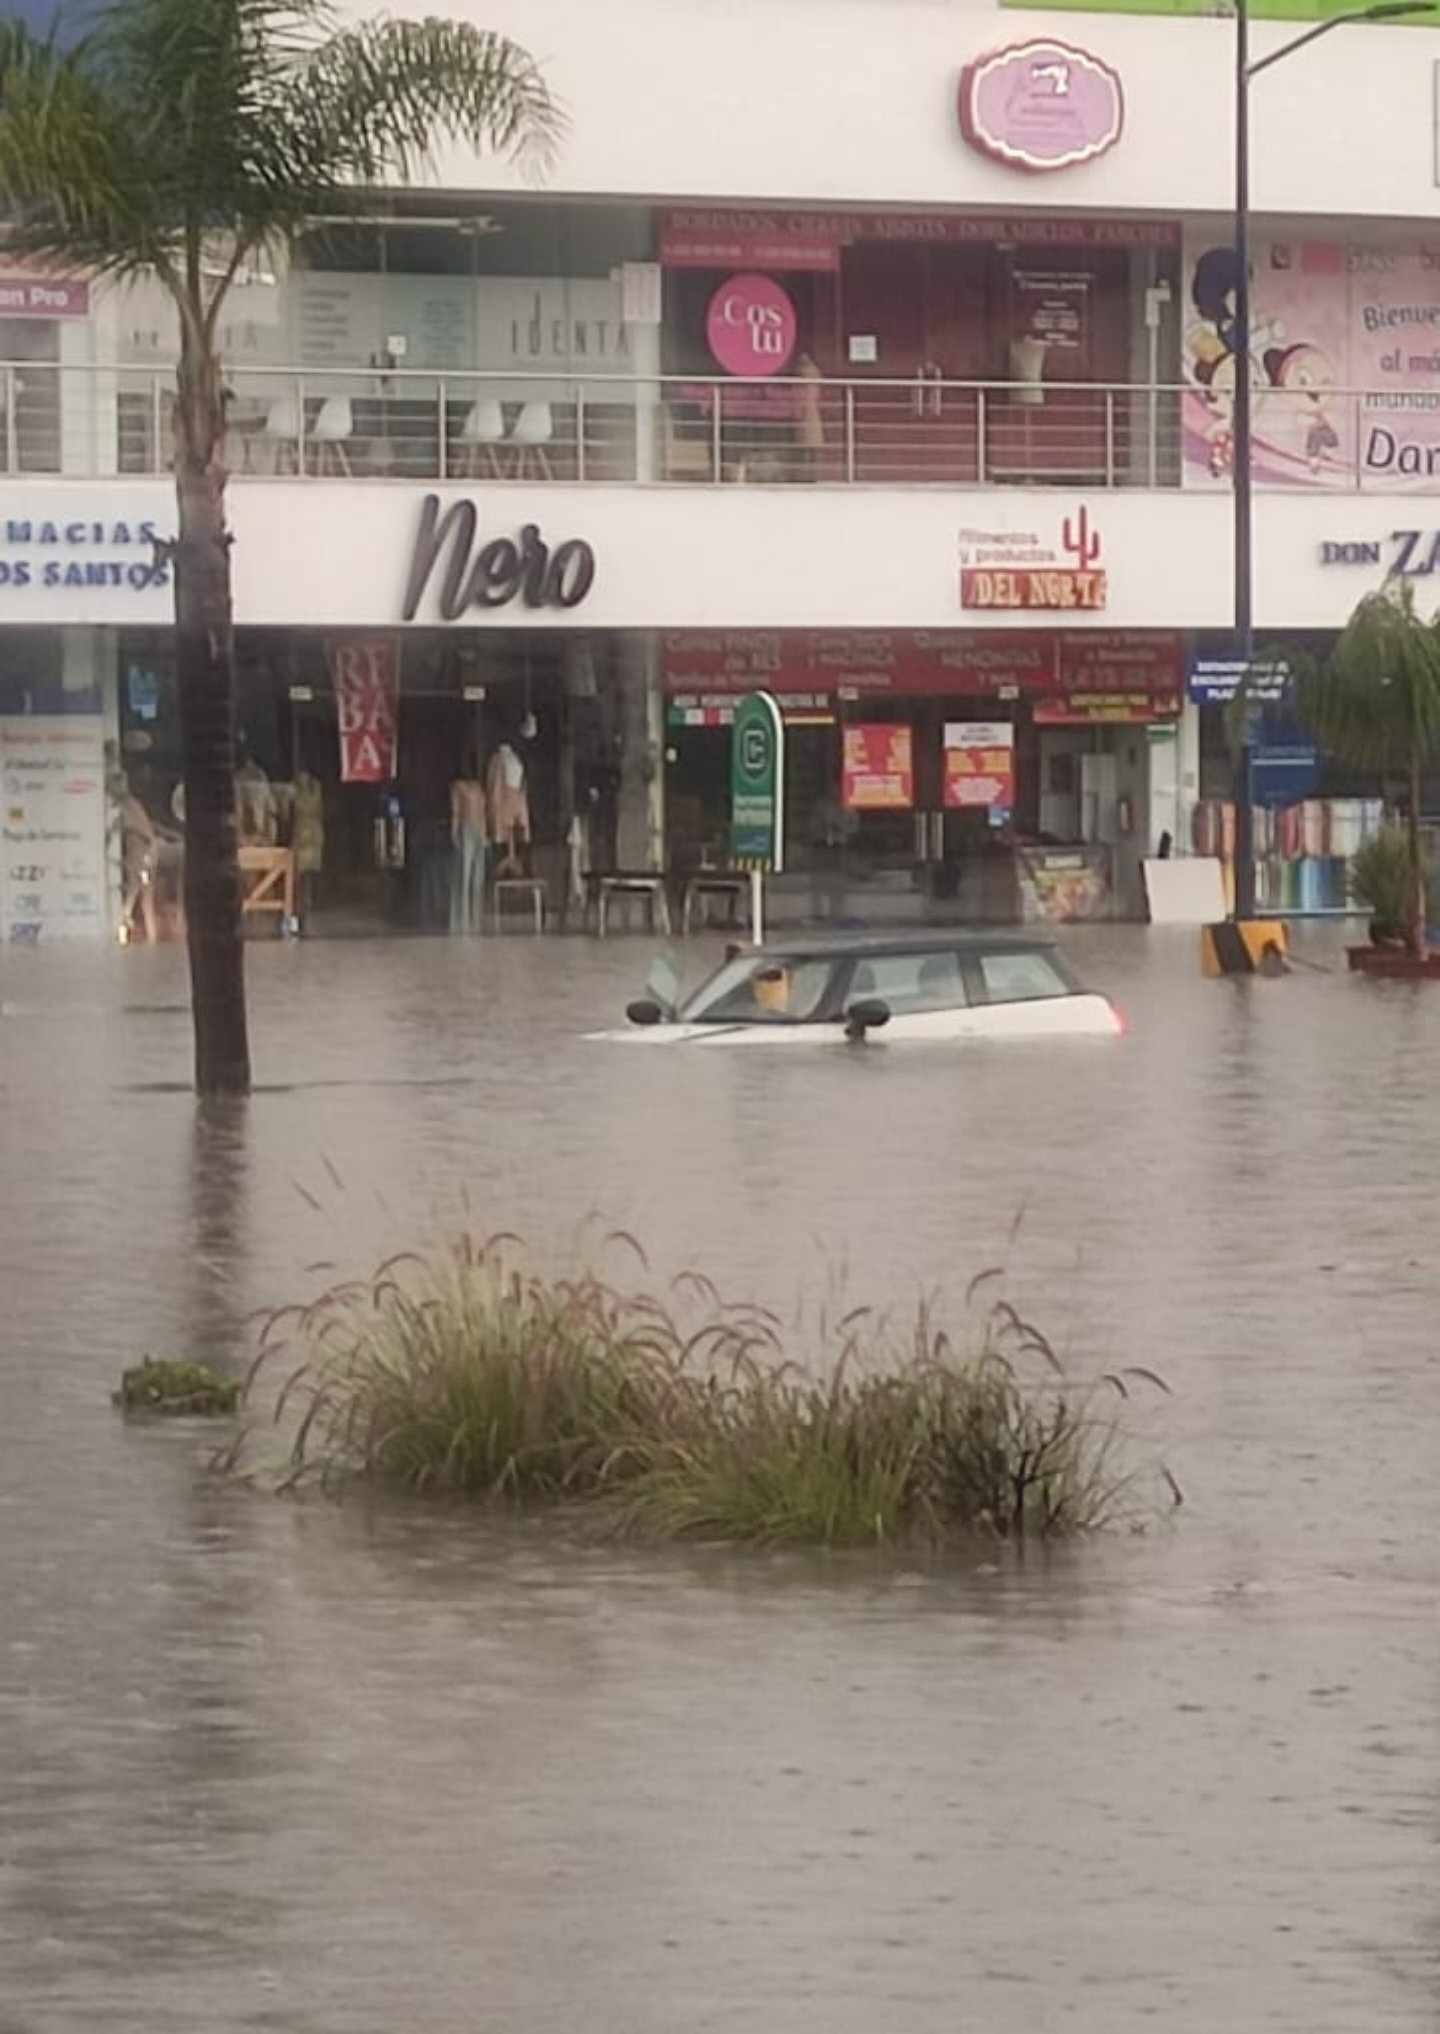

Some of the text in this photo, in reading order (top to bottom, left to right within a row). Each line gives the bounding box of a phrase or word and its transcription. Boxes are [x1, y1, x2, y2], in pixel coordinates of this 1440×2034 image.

[402, 494, 595, 621] Nero
[1321, 540, 1380, 567] DON
[974, 572, 1022, 606] DEL
